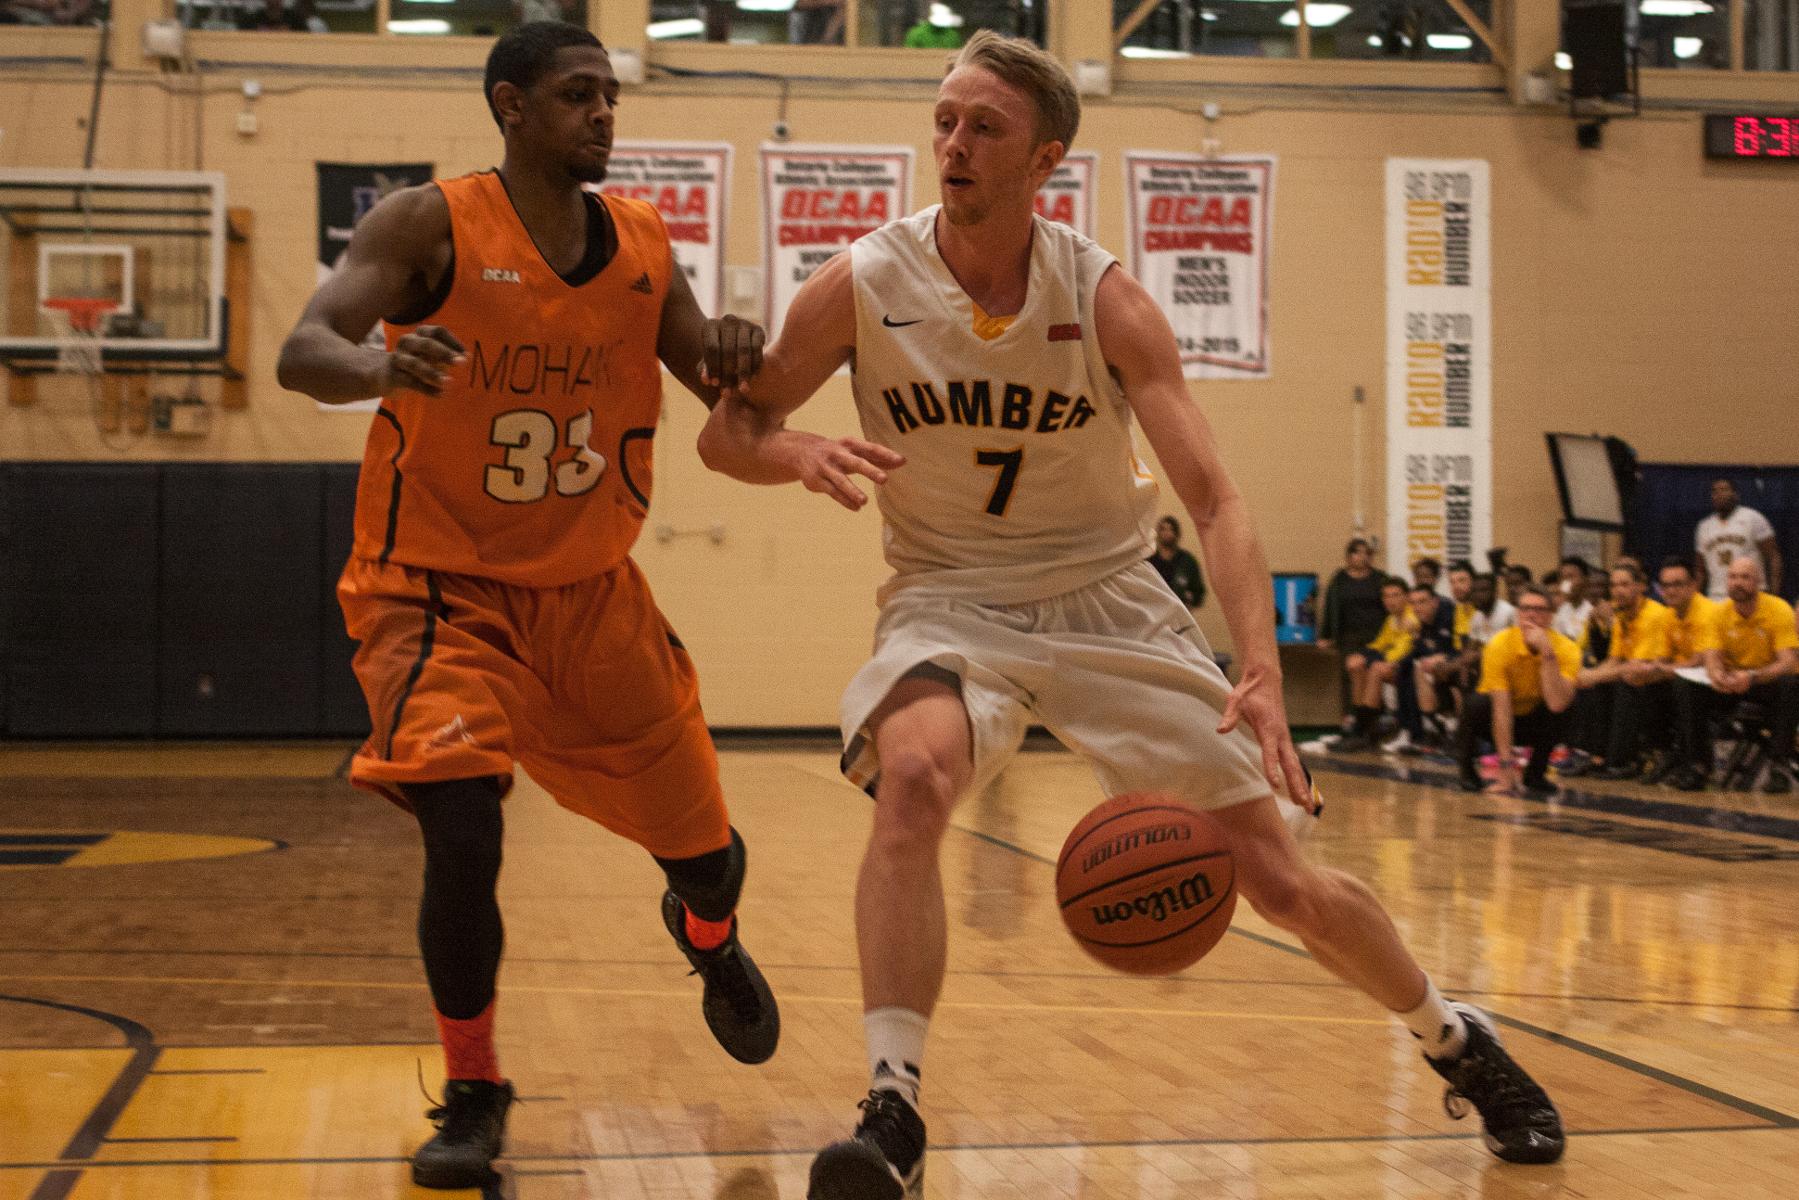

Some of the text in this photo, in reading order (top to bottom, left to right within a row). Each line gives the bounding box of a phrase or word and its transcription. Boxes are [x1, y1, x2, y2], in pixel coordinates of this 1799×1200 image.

[1734, 116, 1799, 156] 8:3
[782, 189, 887, 220] OCAA
[1147, 196, 1251, 227] OCAA
[1178, 256, 1226, 271] MEN'S
[881, 376, 1097, 434] HUMBER
[973, 443, 1025, 517] 7
[1092, 872, 1214, 925] Wilson
